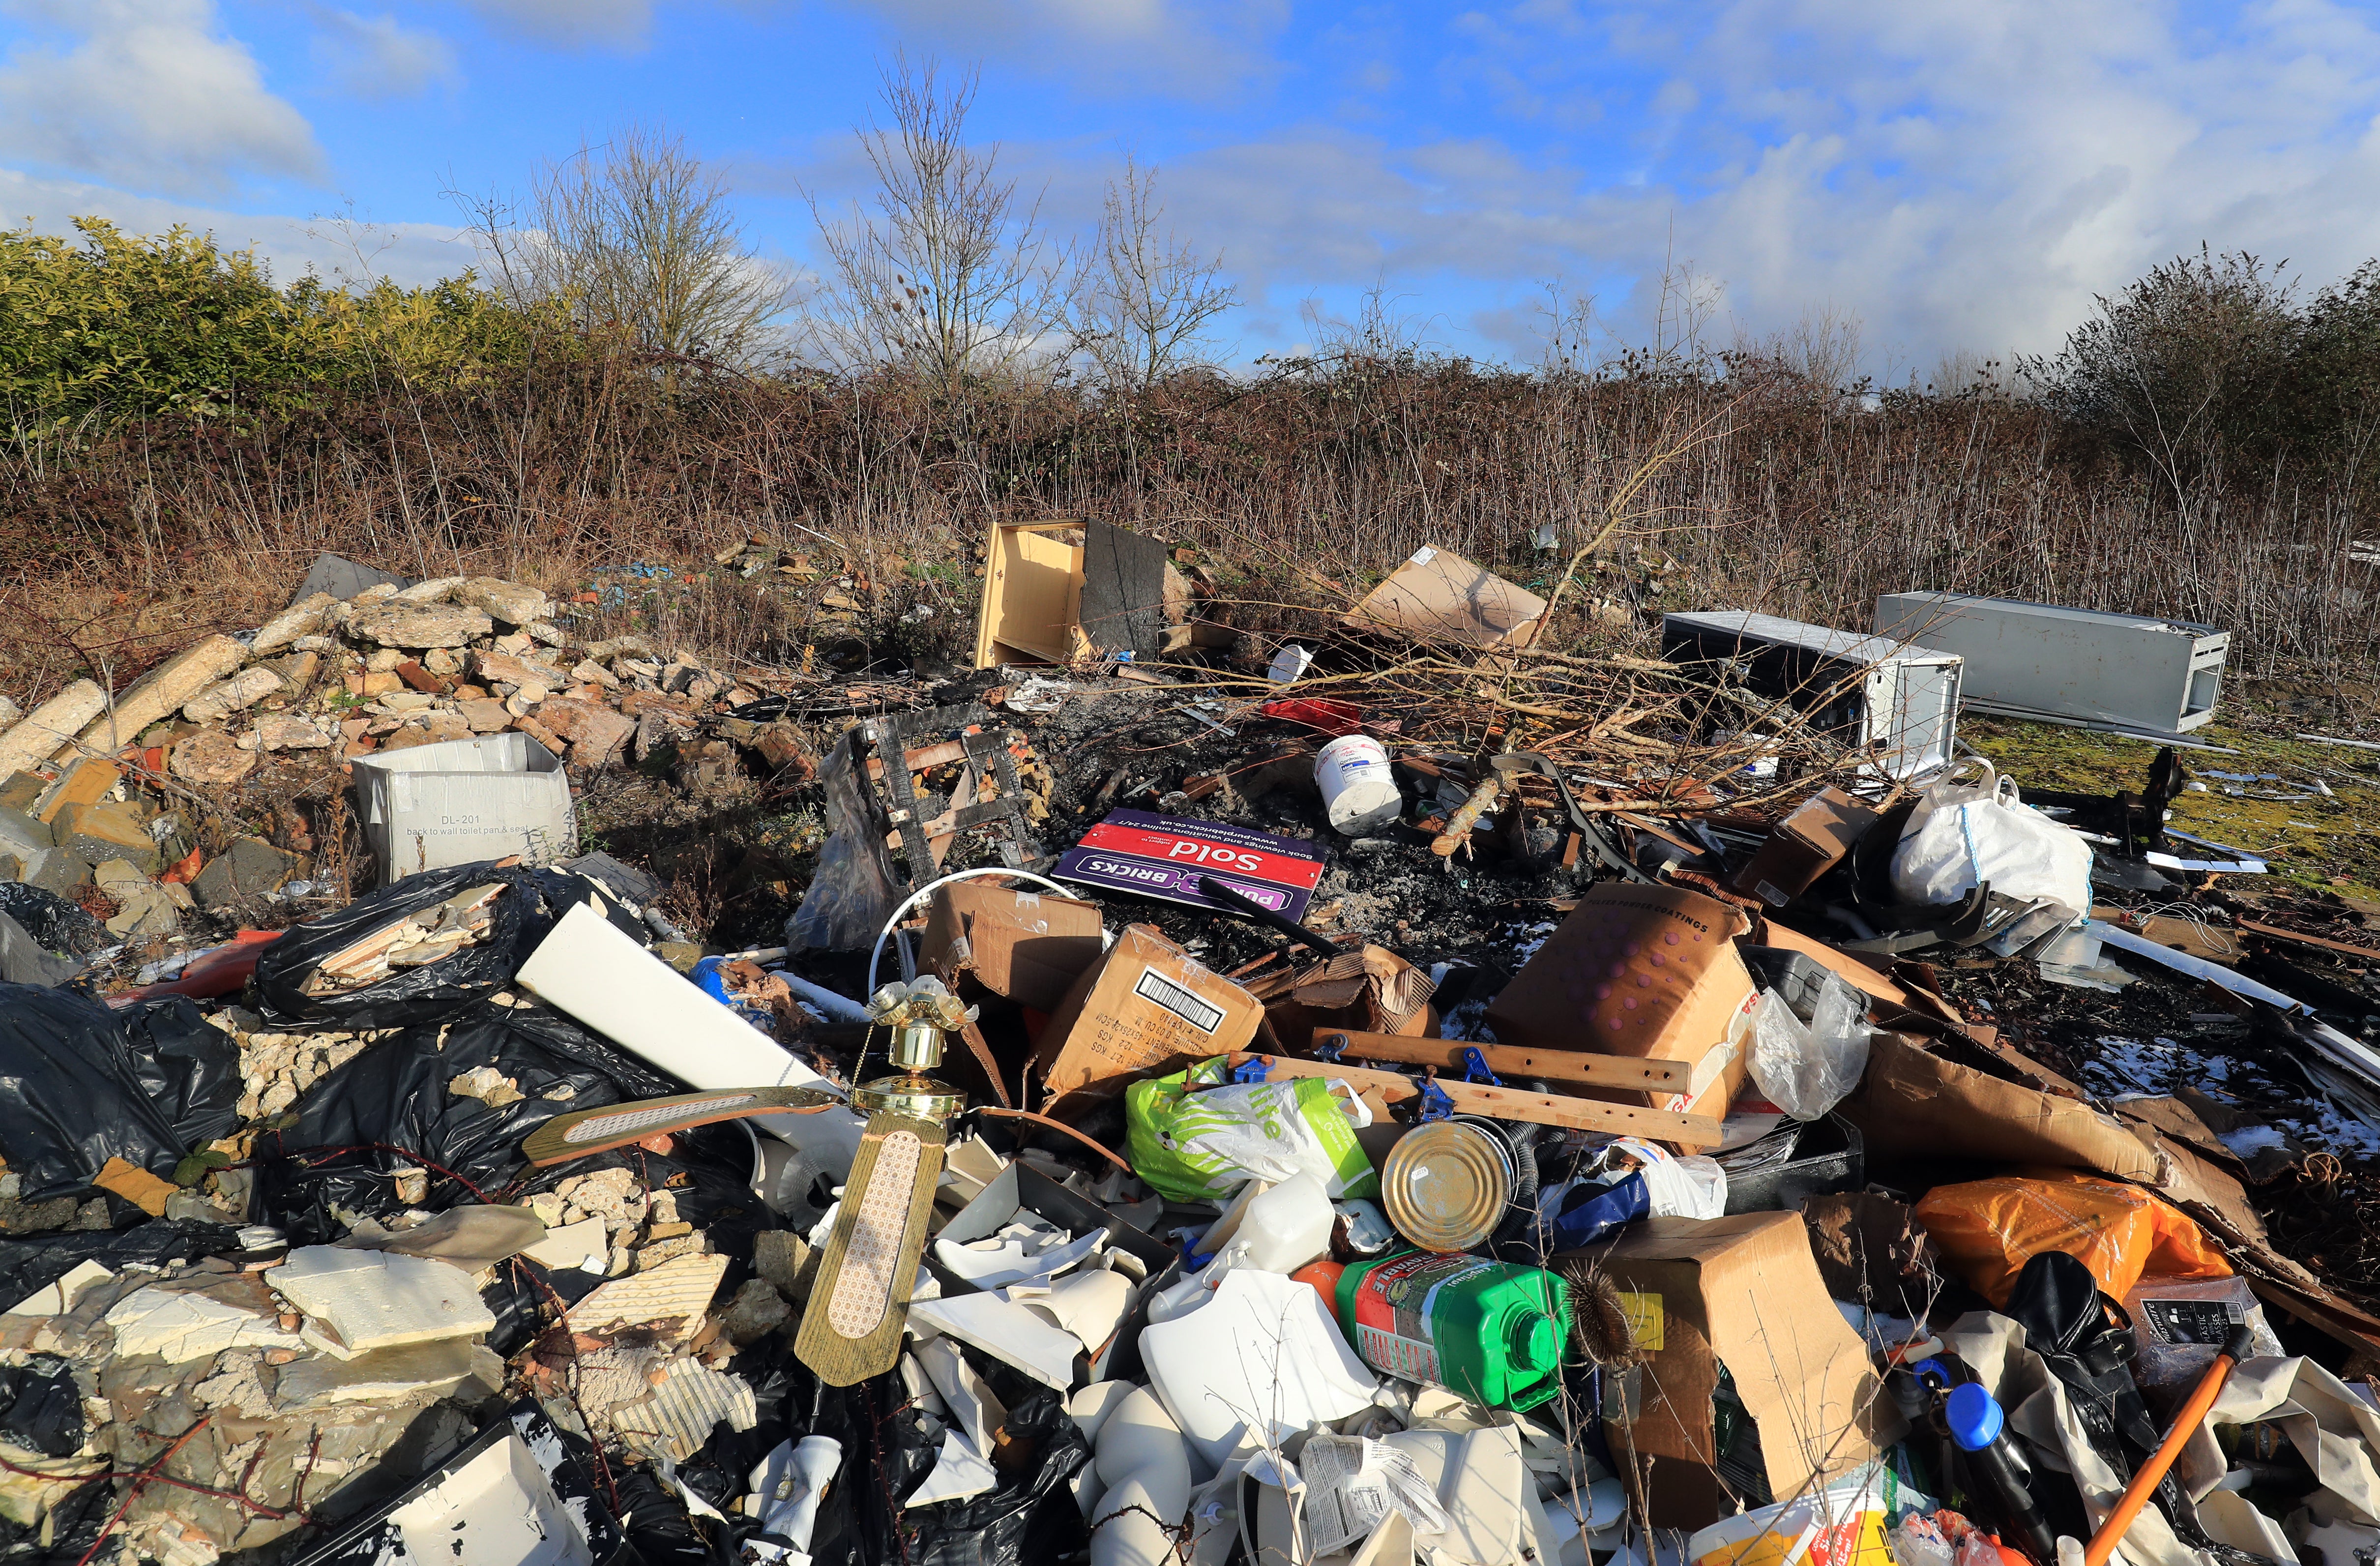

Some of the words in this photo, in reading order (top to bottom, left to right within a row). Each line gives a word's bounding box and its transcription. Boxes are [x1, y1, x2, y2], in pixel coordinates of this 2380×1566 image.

[1340, 756, 1361, 765] Contract
[1142, 823, 1171, 831] online
[1160, 820, 1278, 846] www.purplebricks.co.uk
[1173, 828, 1222, 840] valuations
[1223, 835, 1243, 844] and
[1244, 841, 1286, 854] viewings
[1169, 841, 1263, 871] Sold
[1288, 851, 1313, 860] Book
[1089, 860, 1169, 883] BRICKS
[1191, 878, 1274, 905] PUE
[1618, 900, 1652, 910] POWDER
[1654, 906, 1709, 933] COATINGS
[1159, 1012, 1171, 1023] 140
[1172, 1020, 1183, 1030] OF
[1097, 1029, 1113, 1043] KGS
[1091, 1041, 1107, 1056] KGS
[1118, 1039, 1133, 1051] 12.2
[1112, 1052, 1124, 1064] 12.7
[1248, 1085, 1281, 1140] life
[1329, 1131, 1339, 1144] reuse
[1334, 1121, 1347, 1141] recycled
[1346, 1128, 1355, 1141] made
[2042, 1203, 2051, 1211] bag
[2055, 1211, 2068, 1223] made
[2087, 1226, 2098, 1236] you
[1447, 1267, 1492, 1288] Cuprinol
[2197, 1314, 2212, 1343] PLASTIC
[2207, 1322, 2216, 1336] WINE
[2211, 1313, 2226, 1344] GLASSES
